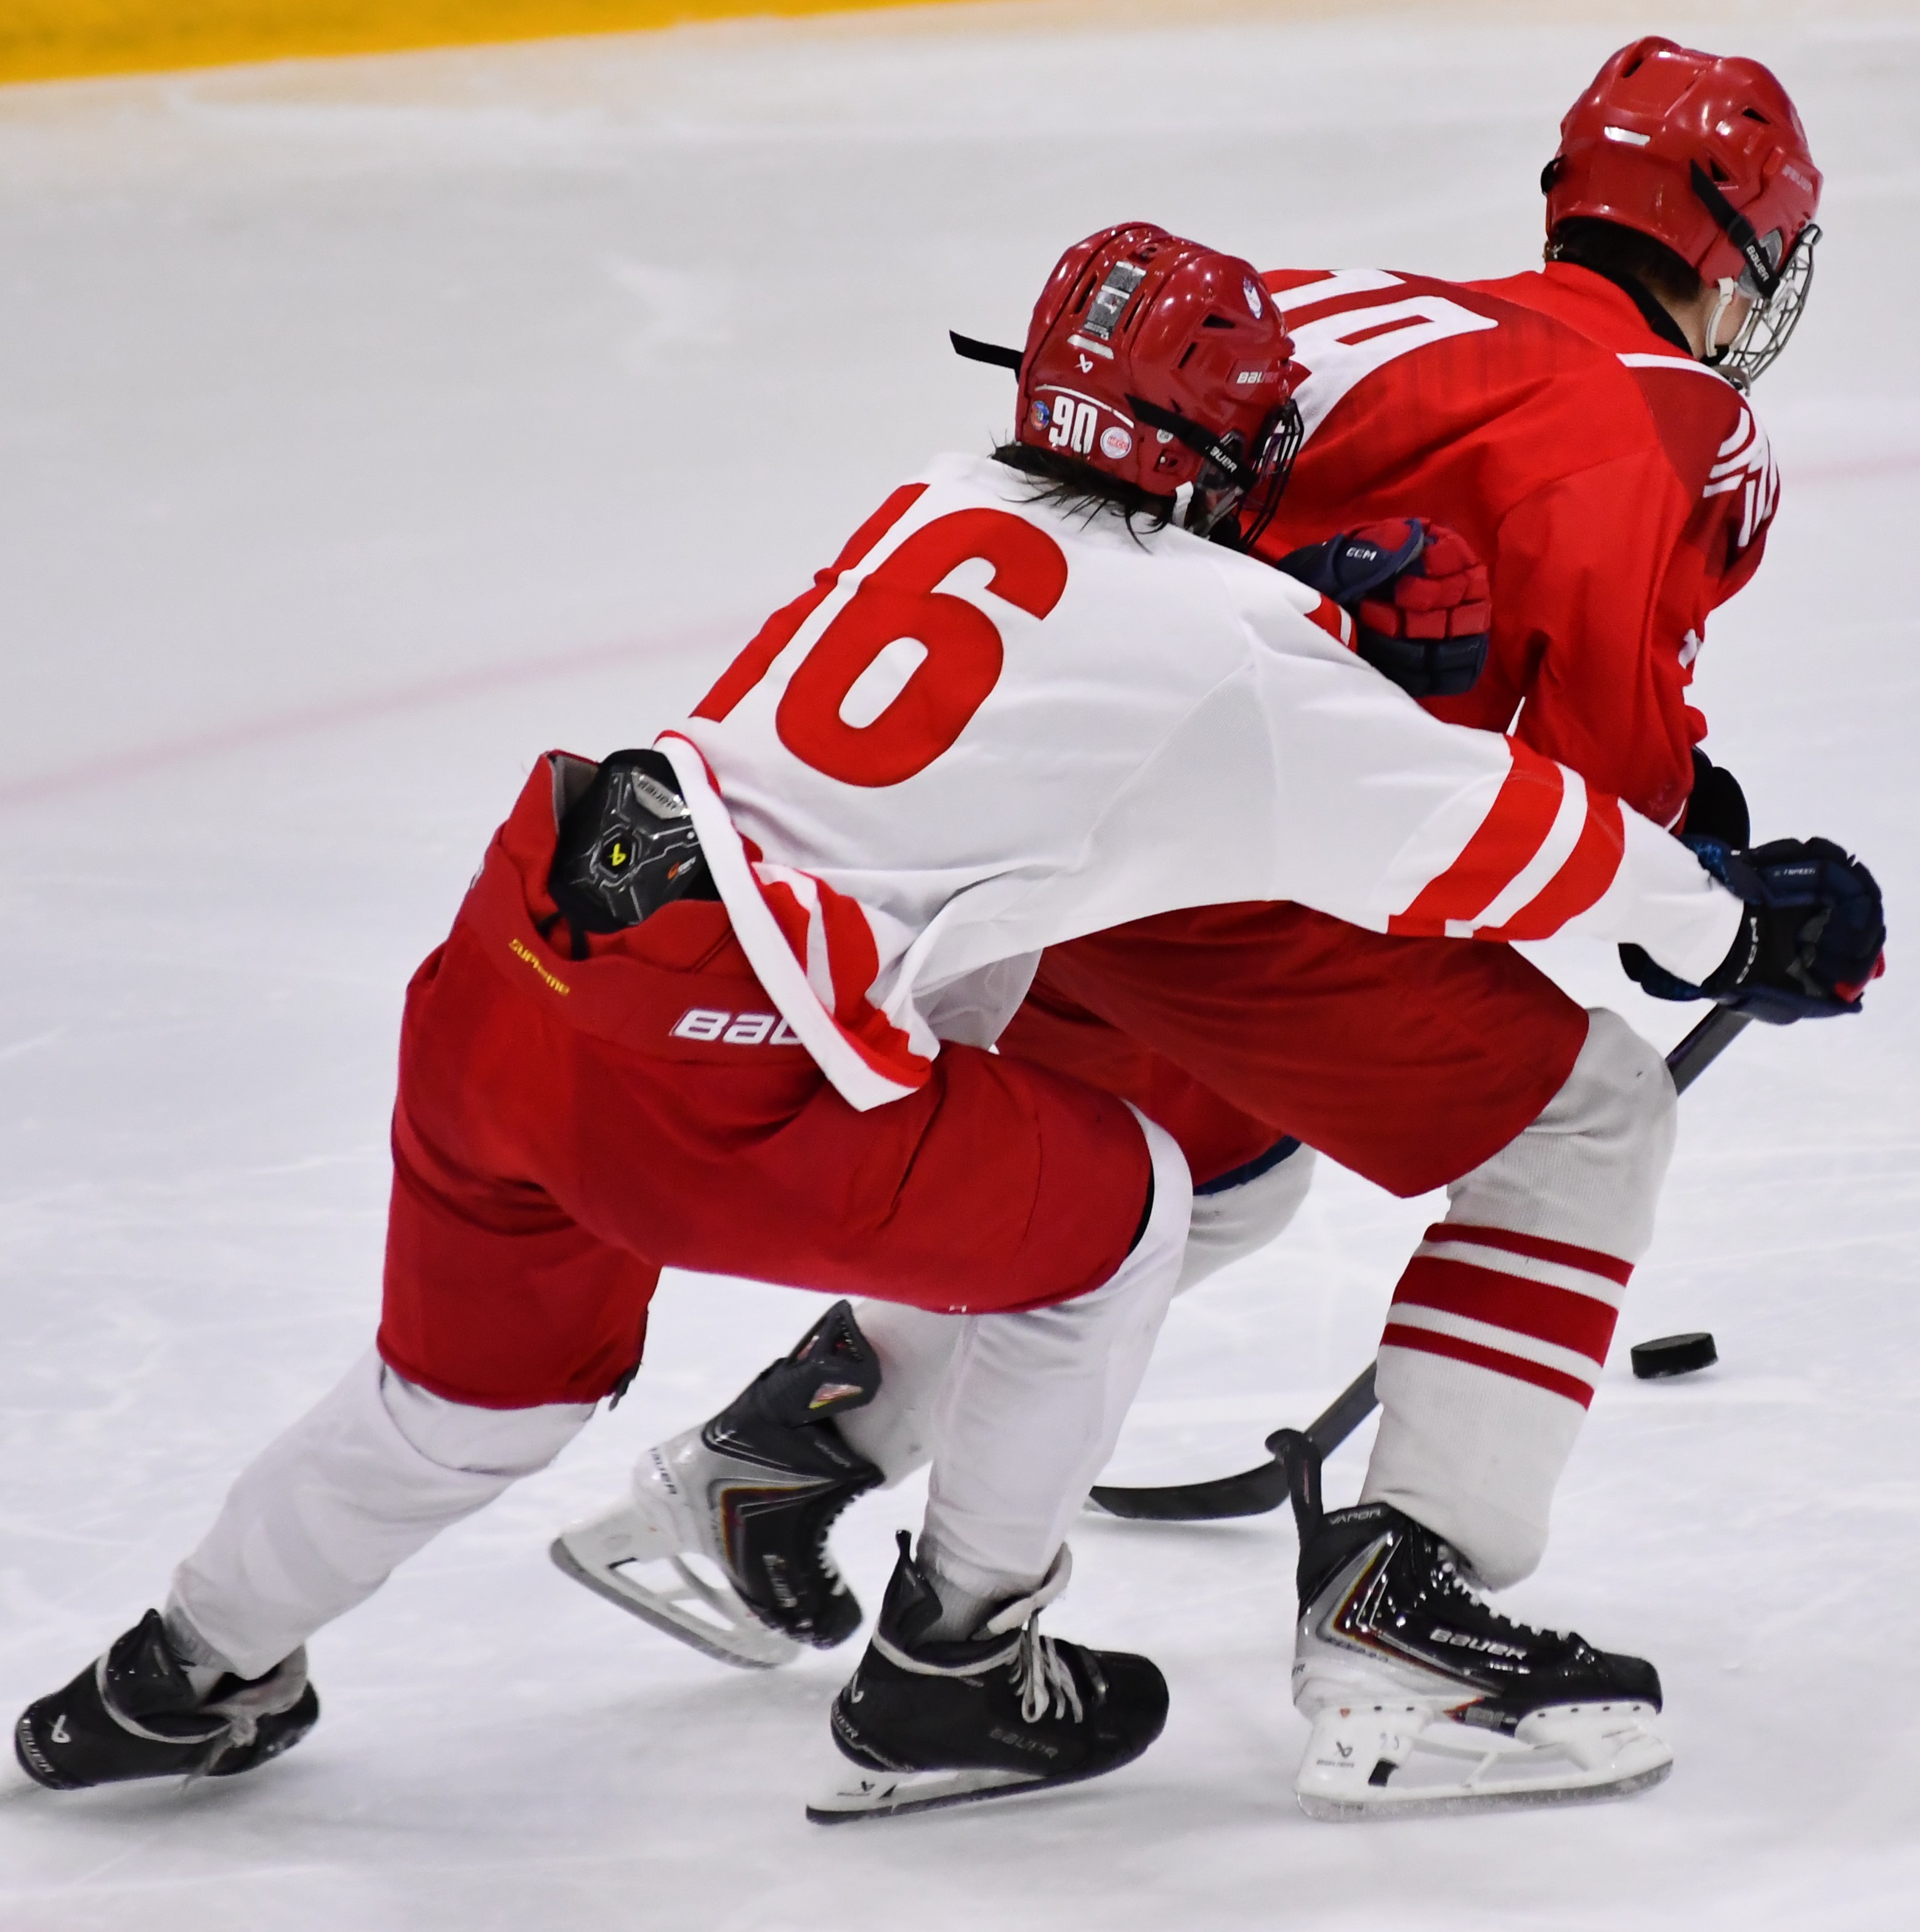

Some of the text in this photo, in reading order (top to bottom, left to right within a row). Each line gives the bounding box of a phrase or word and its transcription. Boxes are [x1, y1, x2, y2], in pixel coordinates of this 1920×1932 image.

[1048, 395, 1098, 455] 90
[1346, 546, 1377, 562] CCM
[688, 482, 1068, 788] 16
[669, 1008, 803, 1046] BAU
